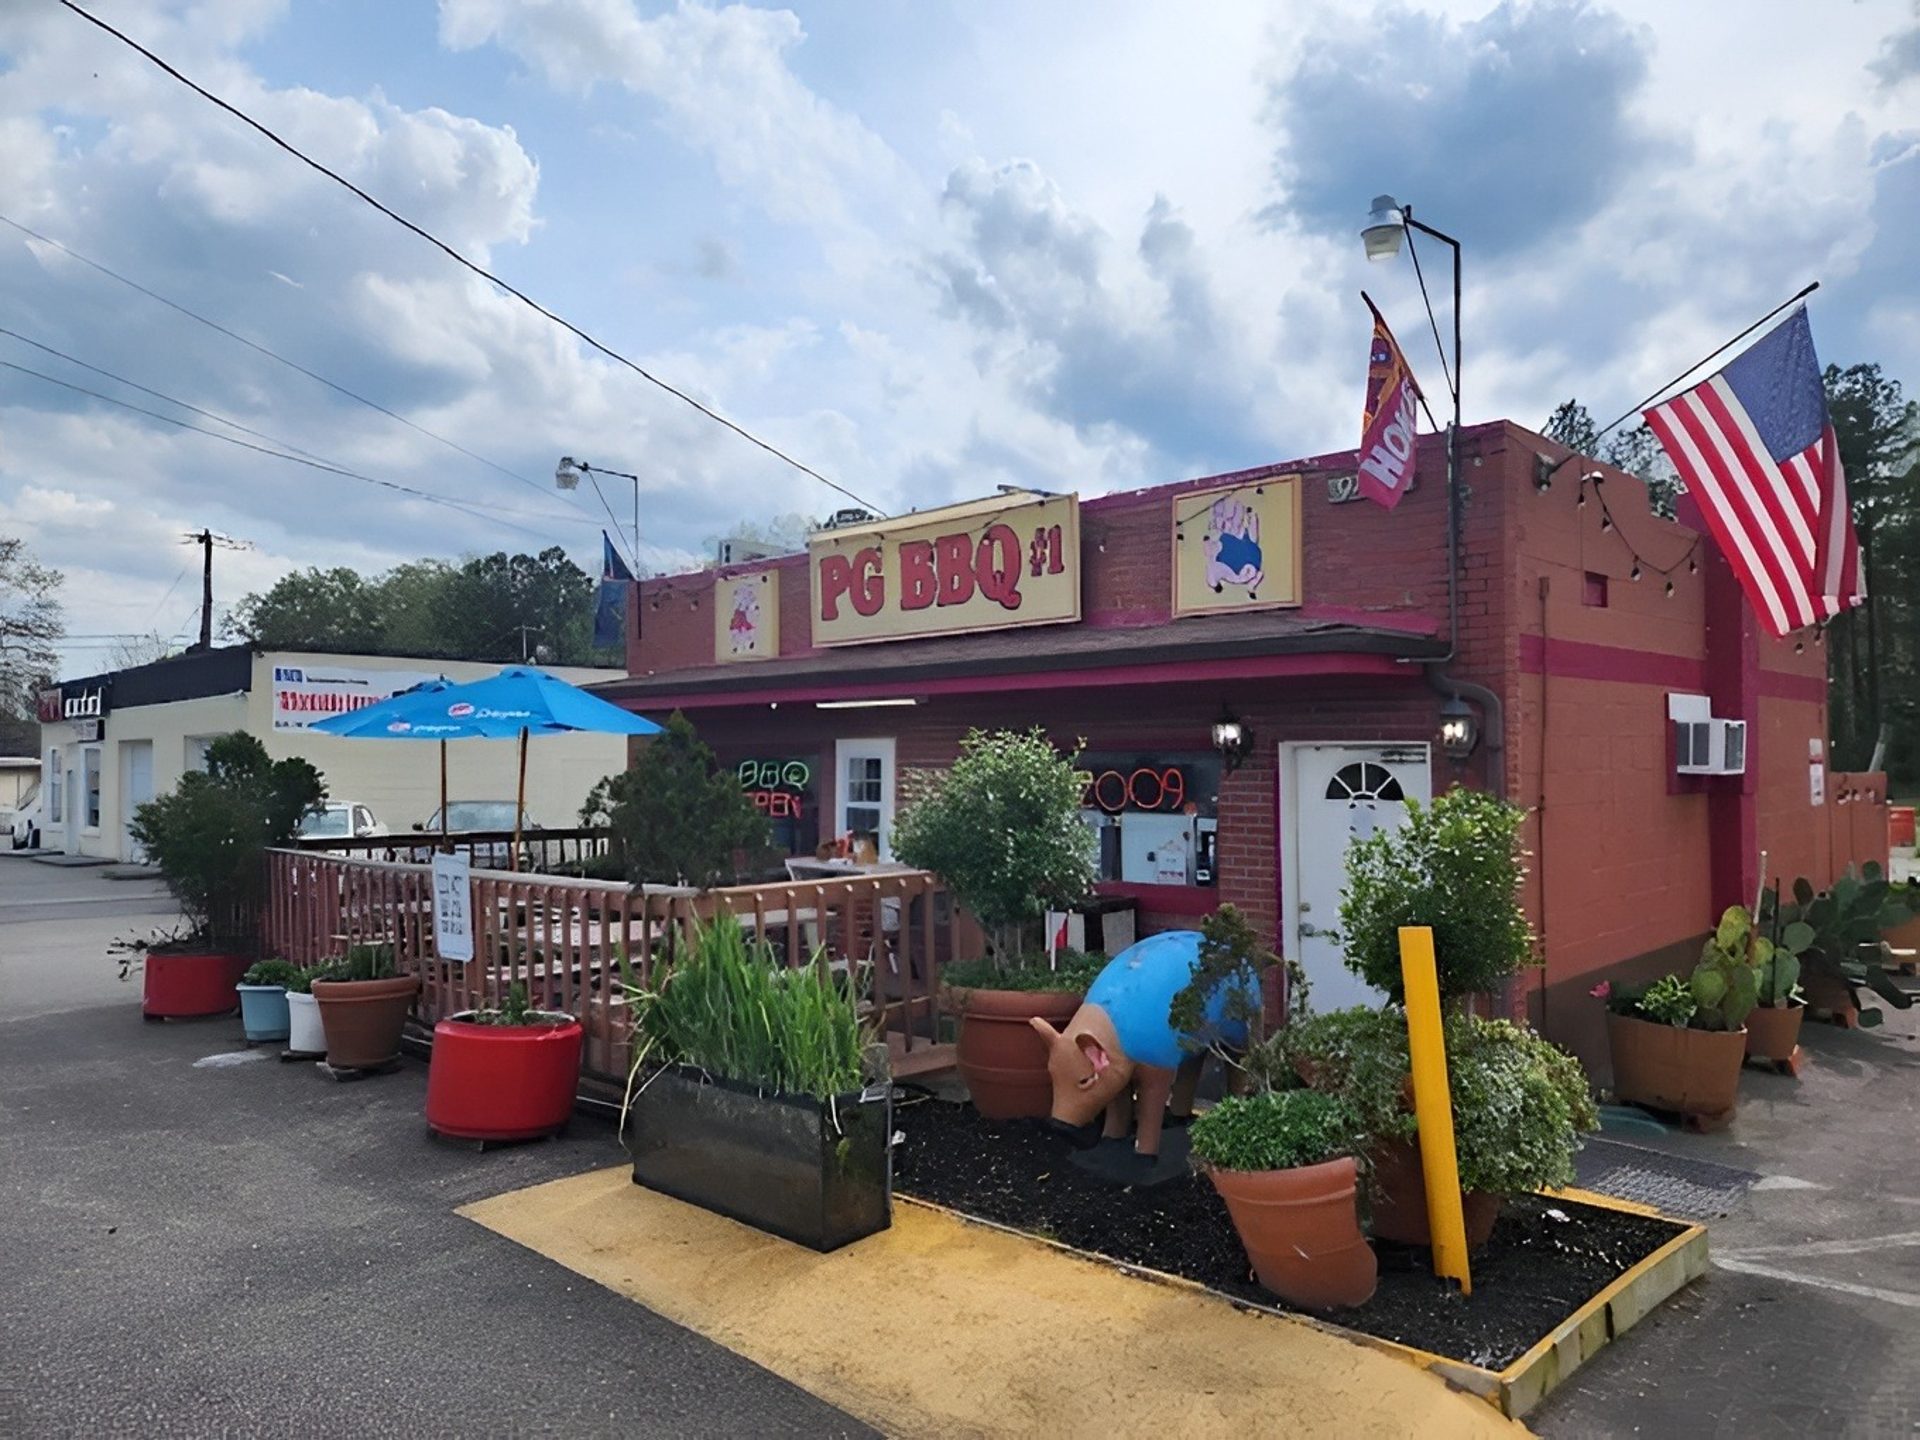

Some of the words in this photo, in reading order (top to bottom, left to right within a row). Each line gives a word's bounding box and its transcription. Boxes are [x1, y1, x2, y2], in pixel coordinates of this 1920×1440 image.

[820, 547, 884, 621] PG
[899, 524, 1022, 610] BBQ
[1030, 524, 1065, 577] #1
[739, 760, 809, 791] BBQ
